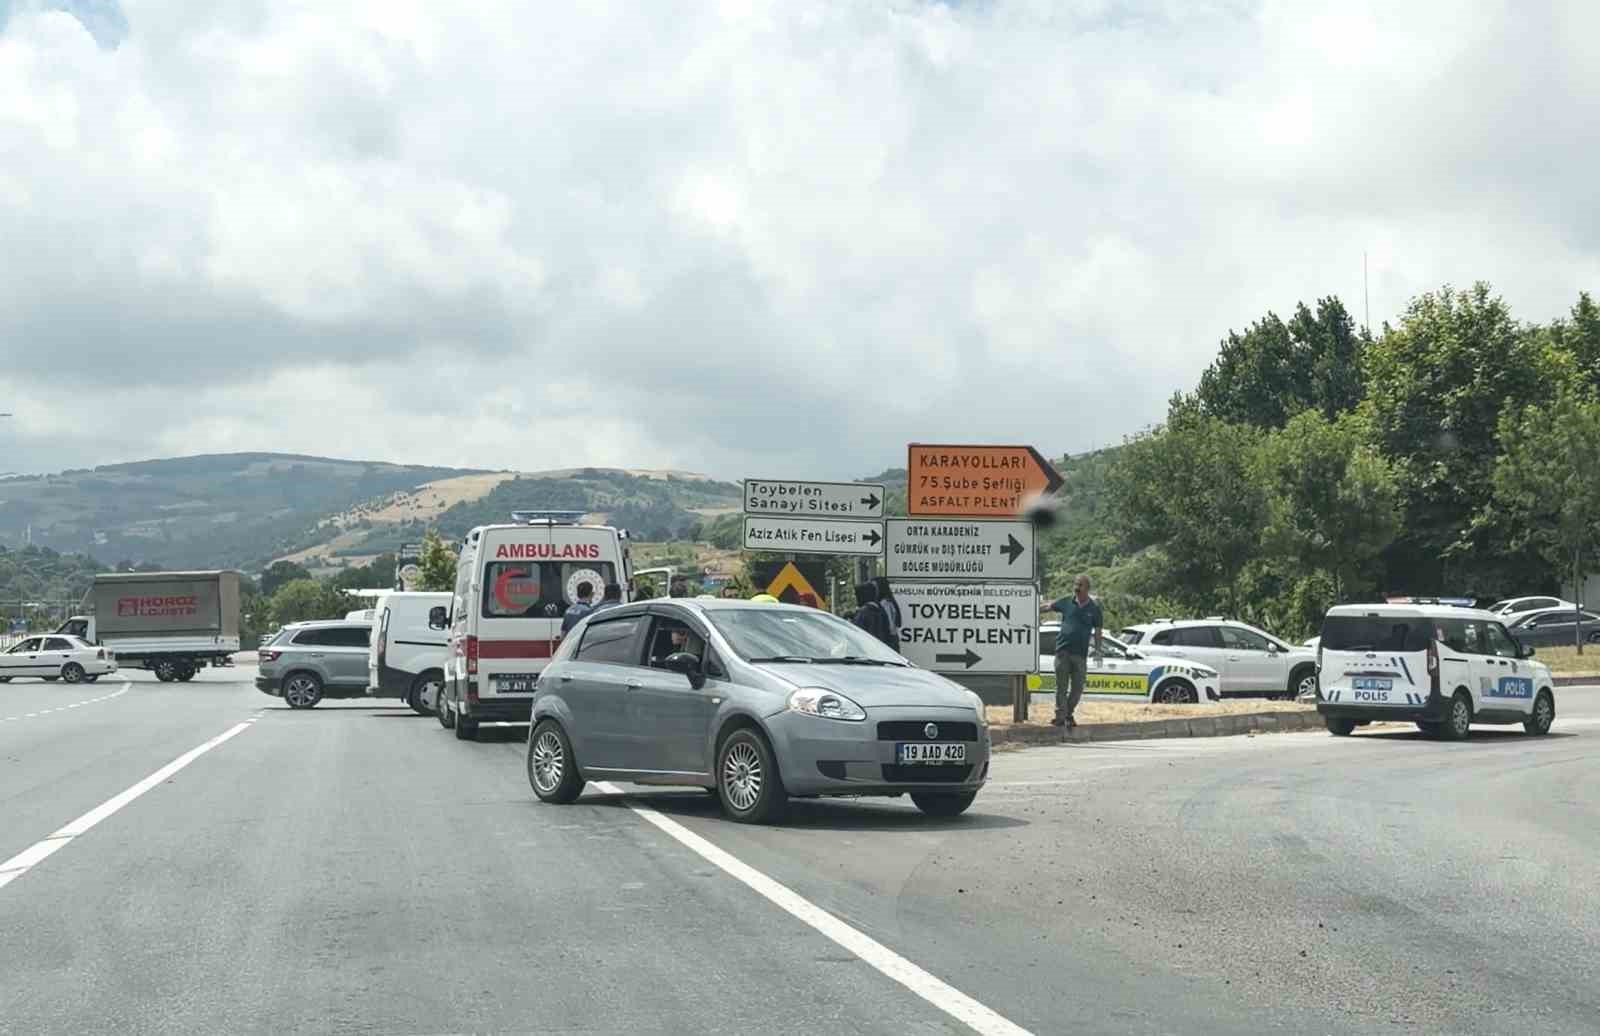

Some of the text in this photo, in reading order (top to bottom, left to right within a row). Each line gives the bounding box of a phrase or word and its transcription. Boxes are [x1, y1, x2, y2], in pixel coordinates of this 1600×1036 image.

[919, 455, 1026, 469] KARAYOLLARI
[750, 483, 822, 497] Toybelen
[750, 497, 853, 512] Sanayi Sitesi
[919, 496, 971, 508] ASFALT
[748, 527, 773, 540] Aziz
[801, 529, 822, 541] Fen
[825, 530, 857, 544] Lisesi
[906, 525, 980, 537] ORTA KARADENİZ
[496, 544, 600, 558] AMBULANS
[894, 542, 929, 555] GÜMRÜK
[957, 542, 992, 556] TİCARET
[902, 560, 984, 573] BÖLGE MÜDÜRLÜĞÜ
[893, 587, 925, 596] AMSUN
[908, 603, 1011, 620] TOYBELEN
[900, 627, 959, 644] SFALT
[1354, 689, 1389, 701] POLİS
[905, 745, 964, 759] 19 AAD 420
